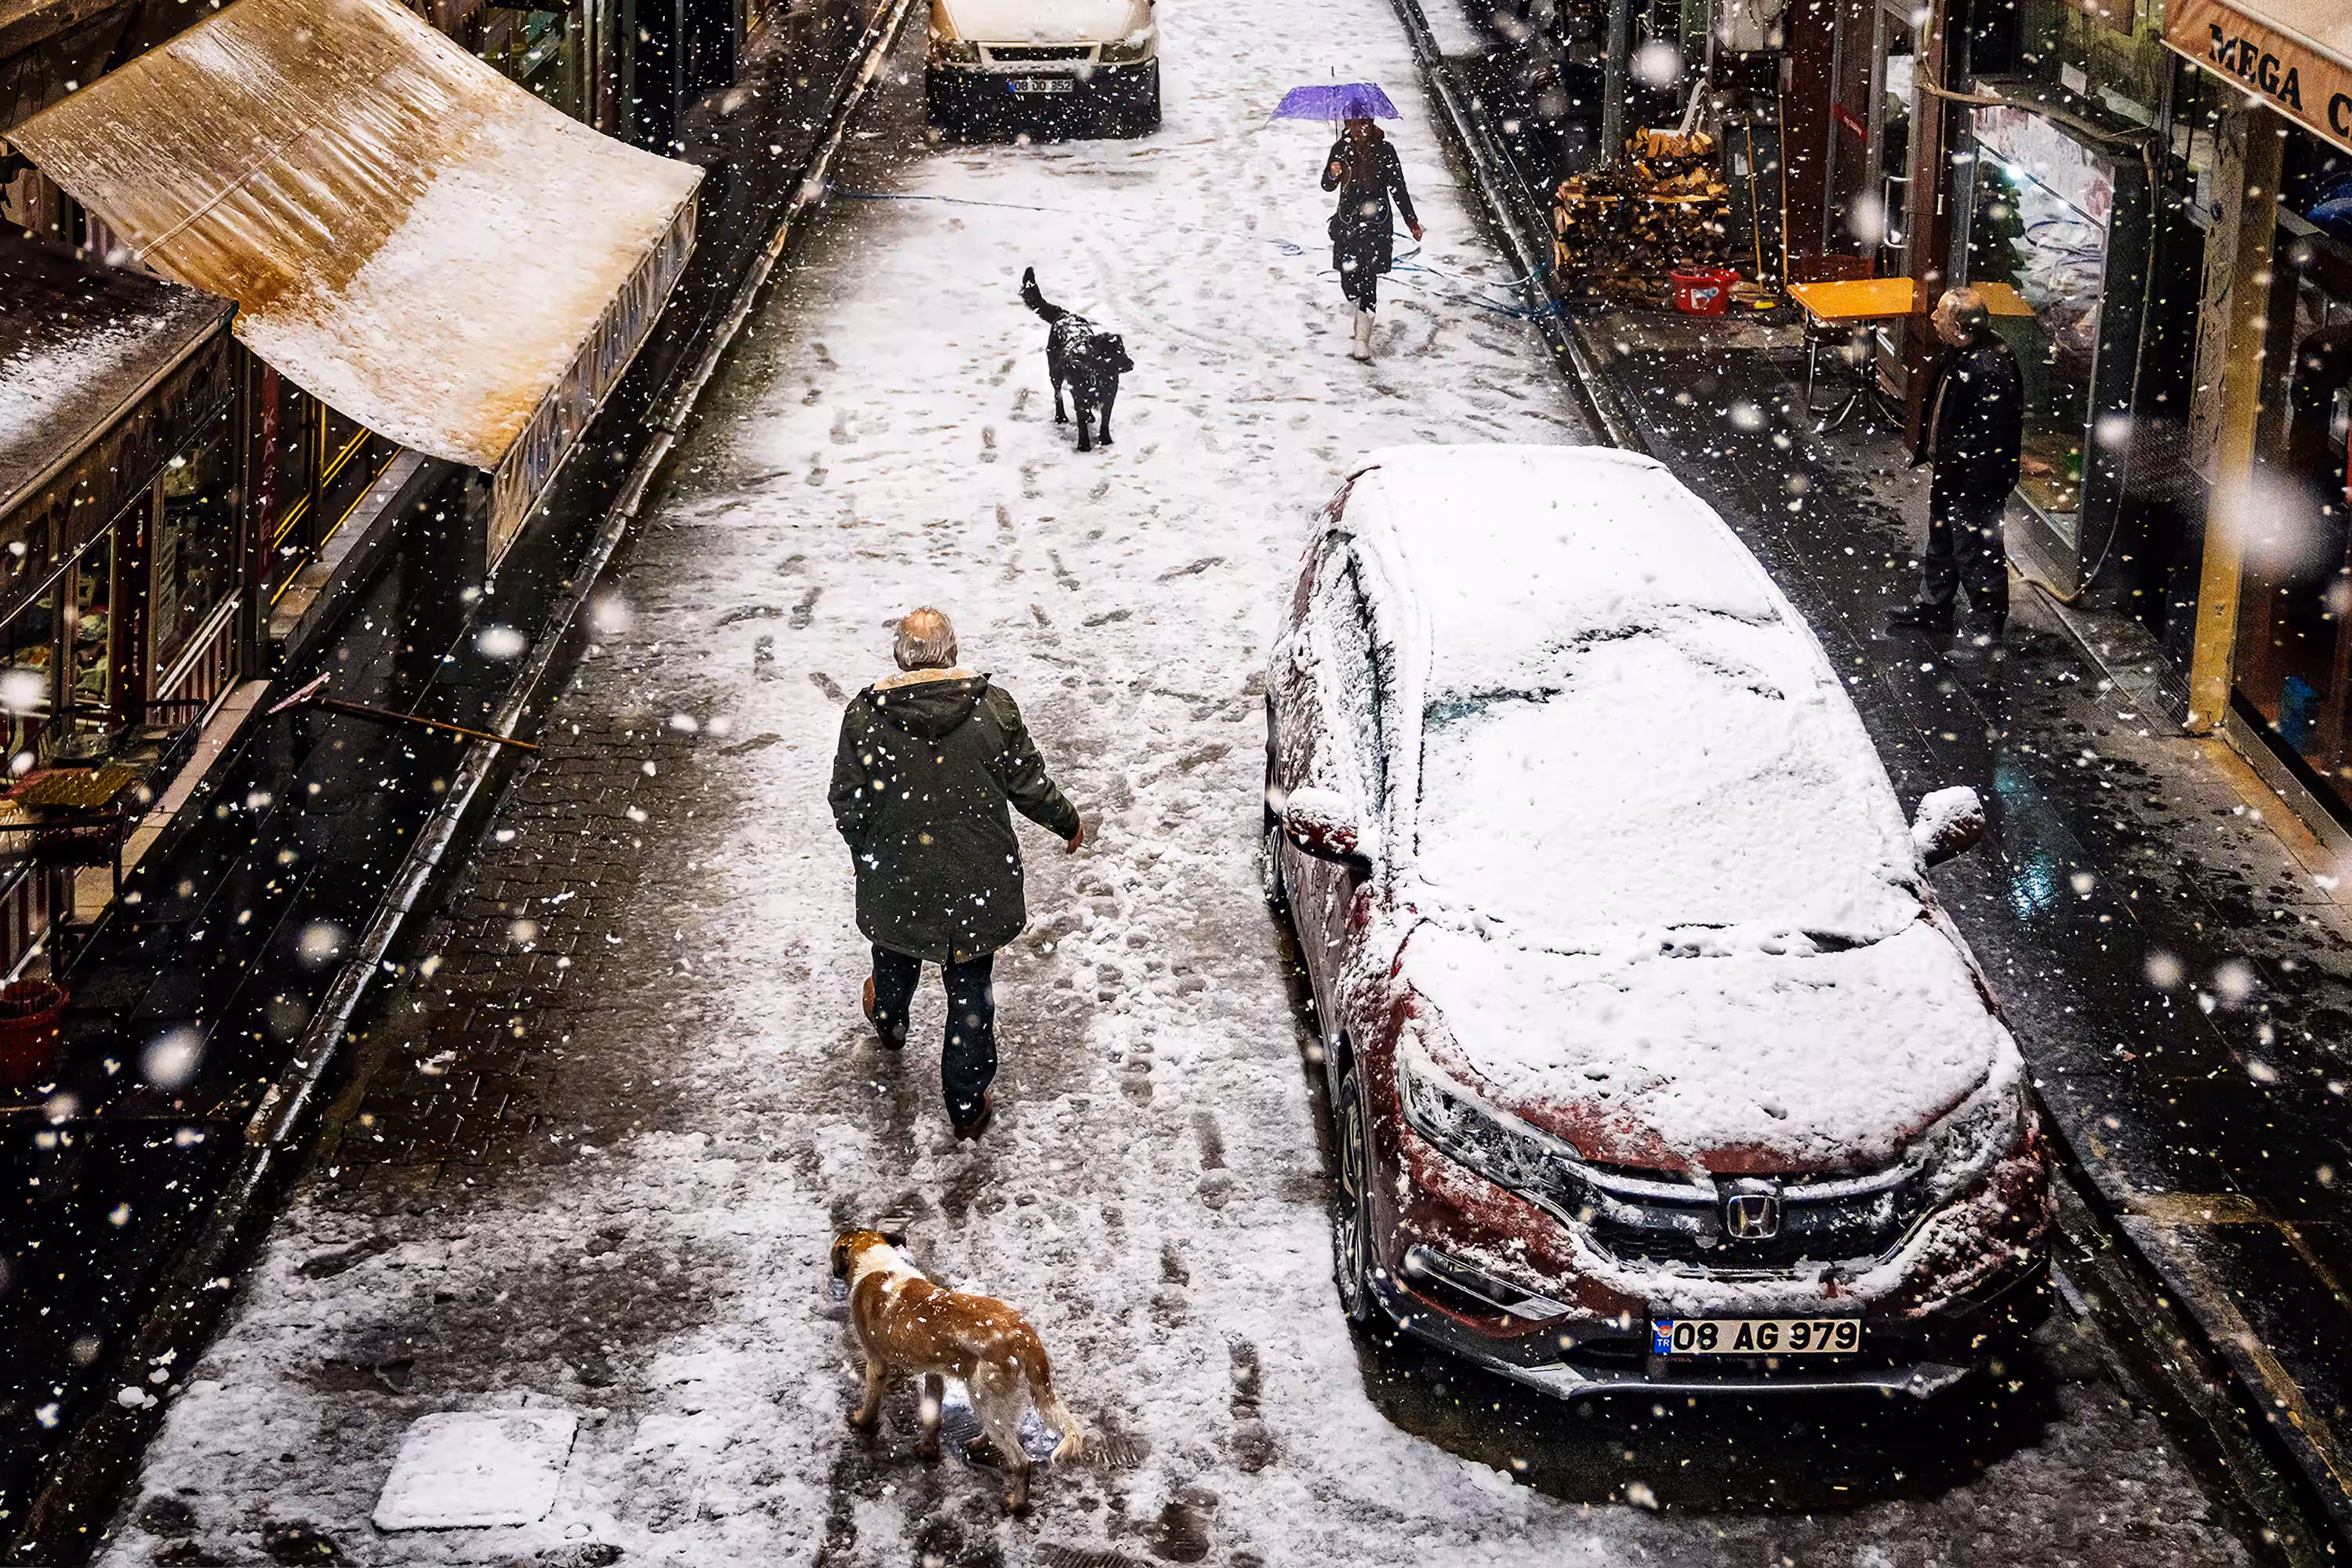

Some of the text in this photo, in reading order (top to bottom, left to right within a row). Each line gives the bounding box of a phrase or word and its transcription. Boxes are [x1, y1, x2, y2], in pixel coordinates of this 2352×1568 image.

[2209, 24, 2303, 112] MEGA
[1014, 82, 1028, 90] 08
[1657, 1338, 1671, 1348] TR
[1673, 1321, 1857, 1350] 08 AG 979
